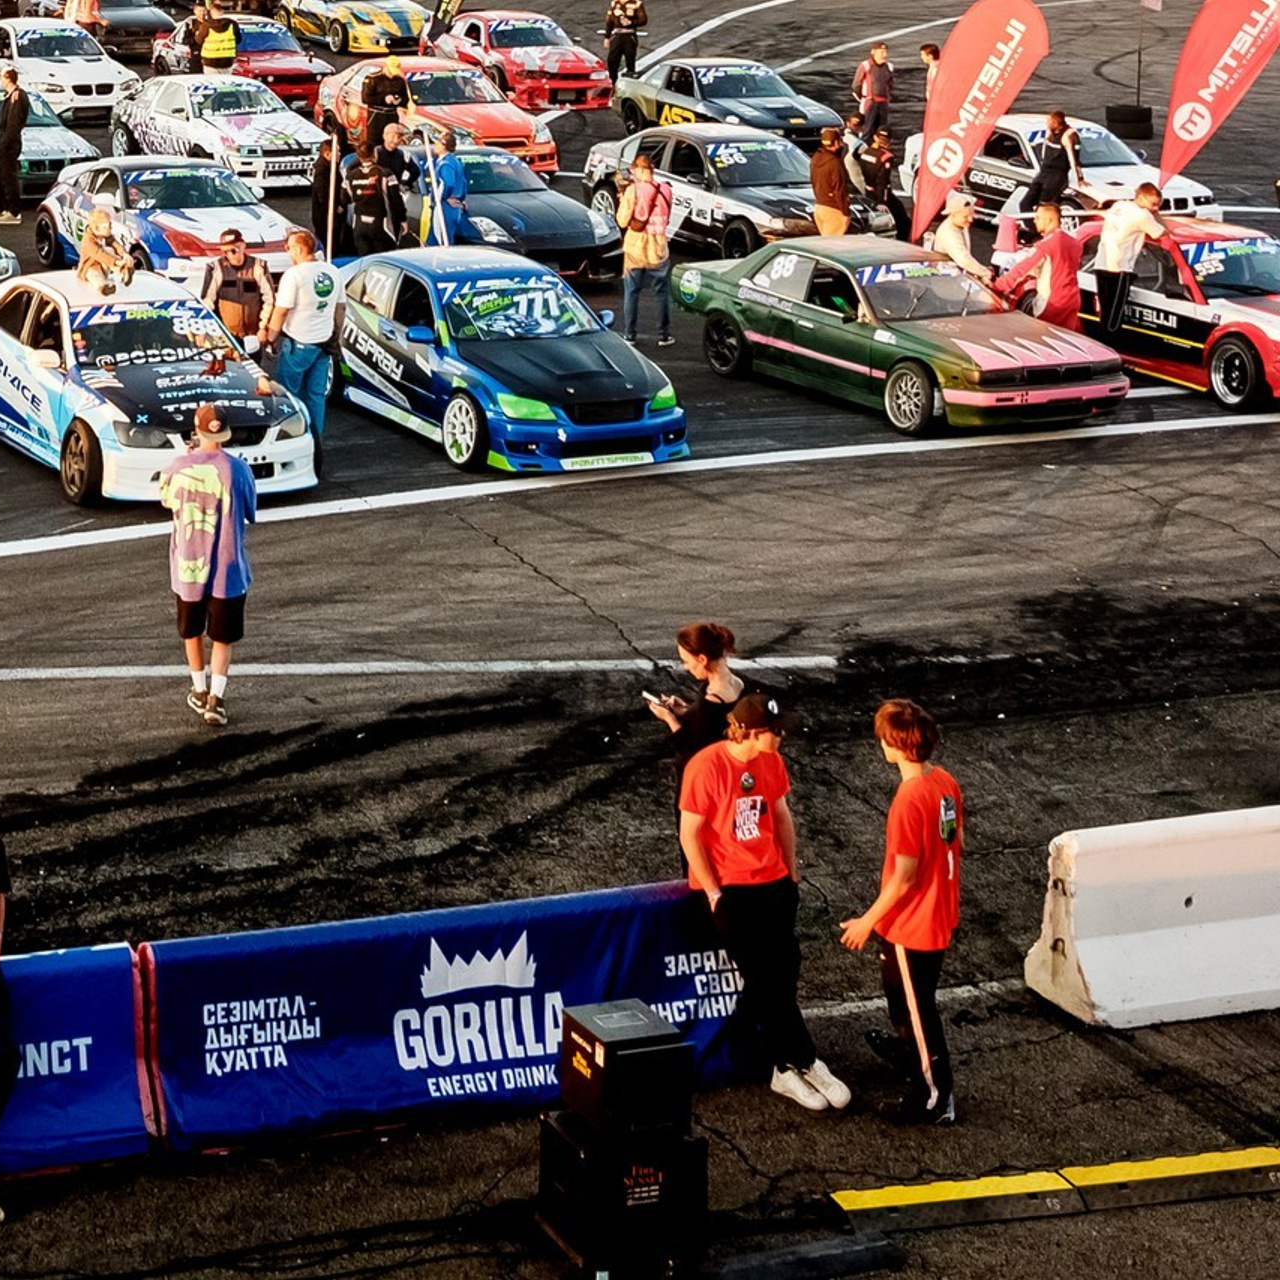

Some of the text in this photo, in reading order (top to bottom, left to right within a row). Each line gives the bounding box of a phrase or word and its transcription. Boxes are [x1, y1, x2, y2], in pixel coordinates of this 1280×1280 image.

[948, 18, 1027, 139] MITSUJI
[721, 152, 748, 165] 66
[968, 169, 1018, 193] GENESIS
[770, 254, 799, 280] 88
[1193, 259, 1226, 277] 555
[370, 271, 394, 300] 771
[513, 290, 561, 322] 771
[173, 317, 221, 336] 888
[664, 949, 738, 977] ЗАРЯД
[204, 1017, 321, 1050] ДЫҒЫҢДЫ
[393, 991, 564, 1070] GORILLA
[205, 1045, 288, 1077] ҚУАТТА
[427, 1070, 498, 1098] ENERGY
[503, 1064, 559, 1091] DRINK
